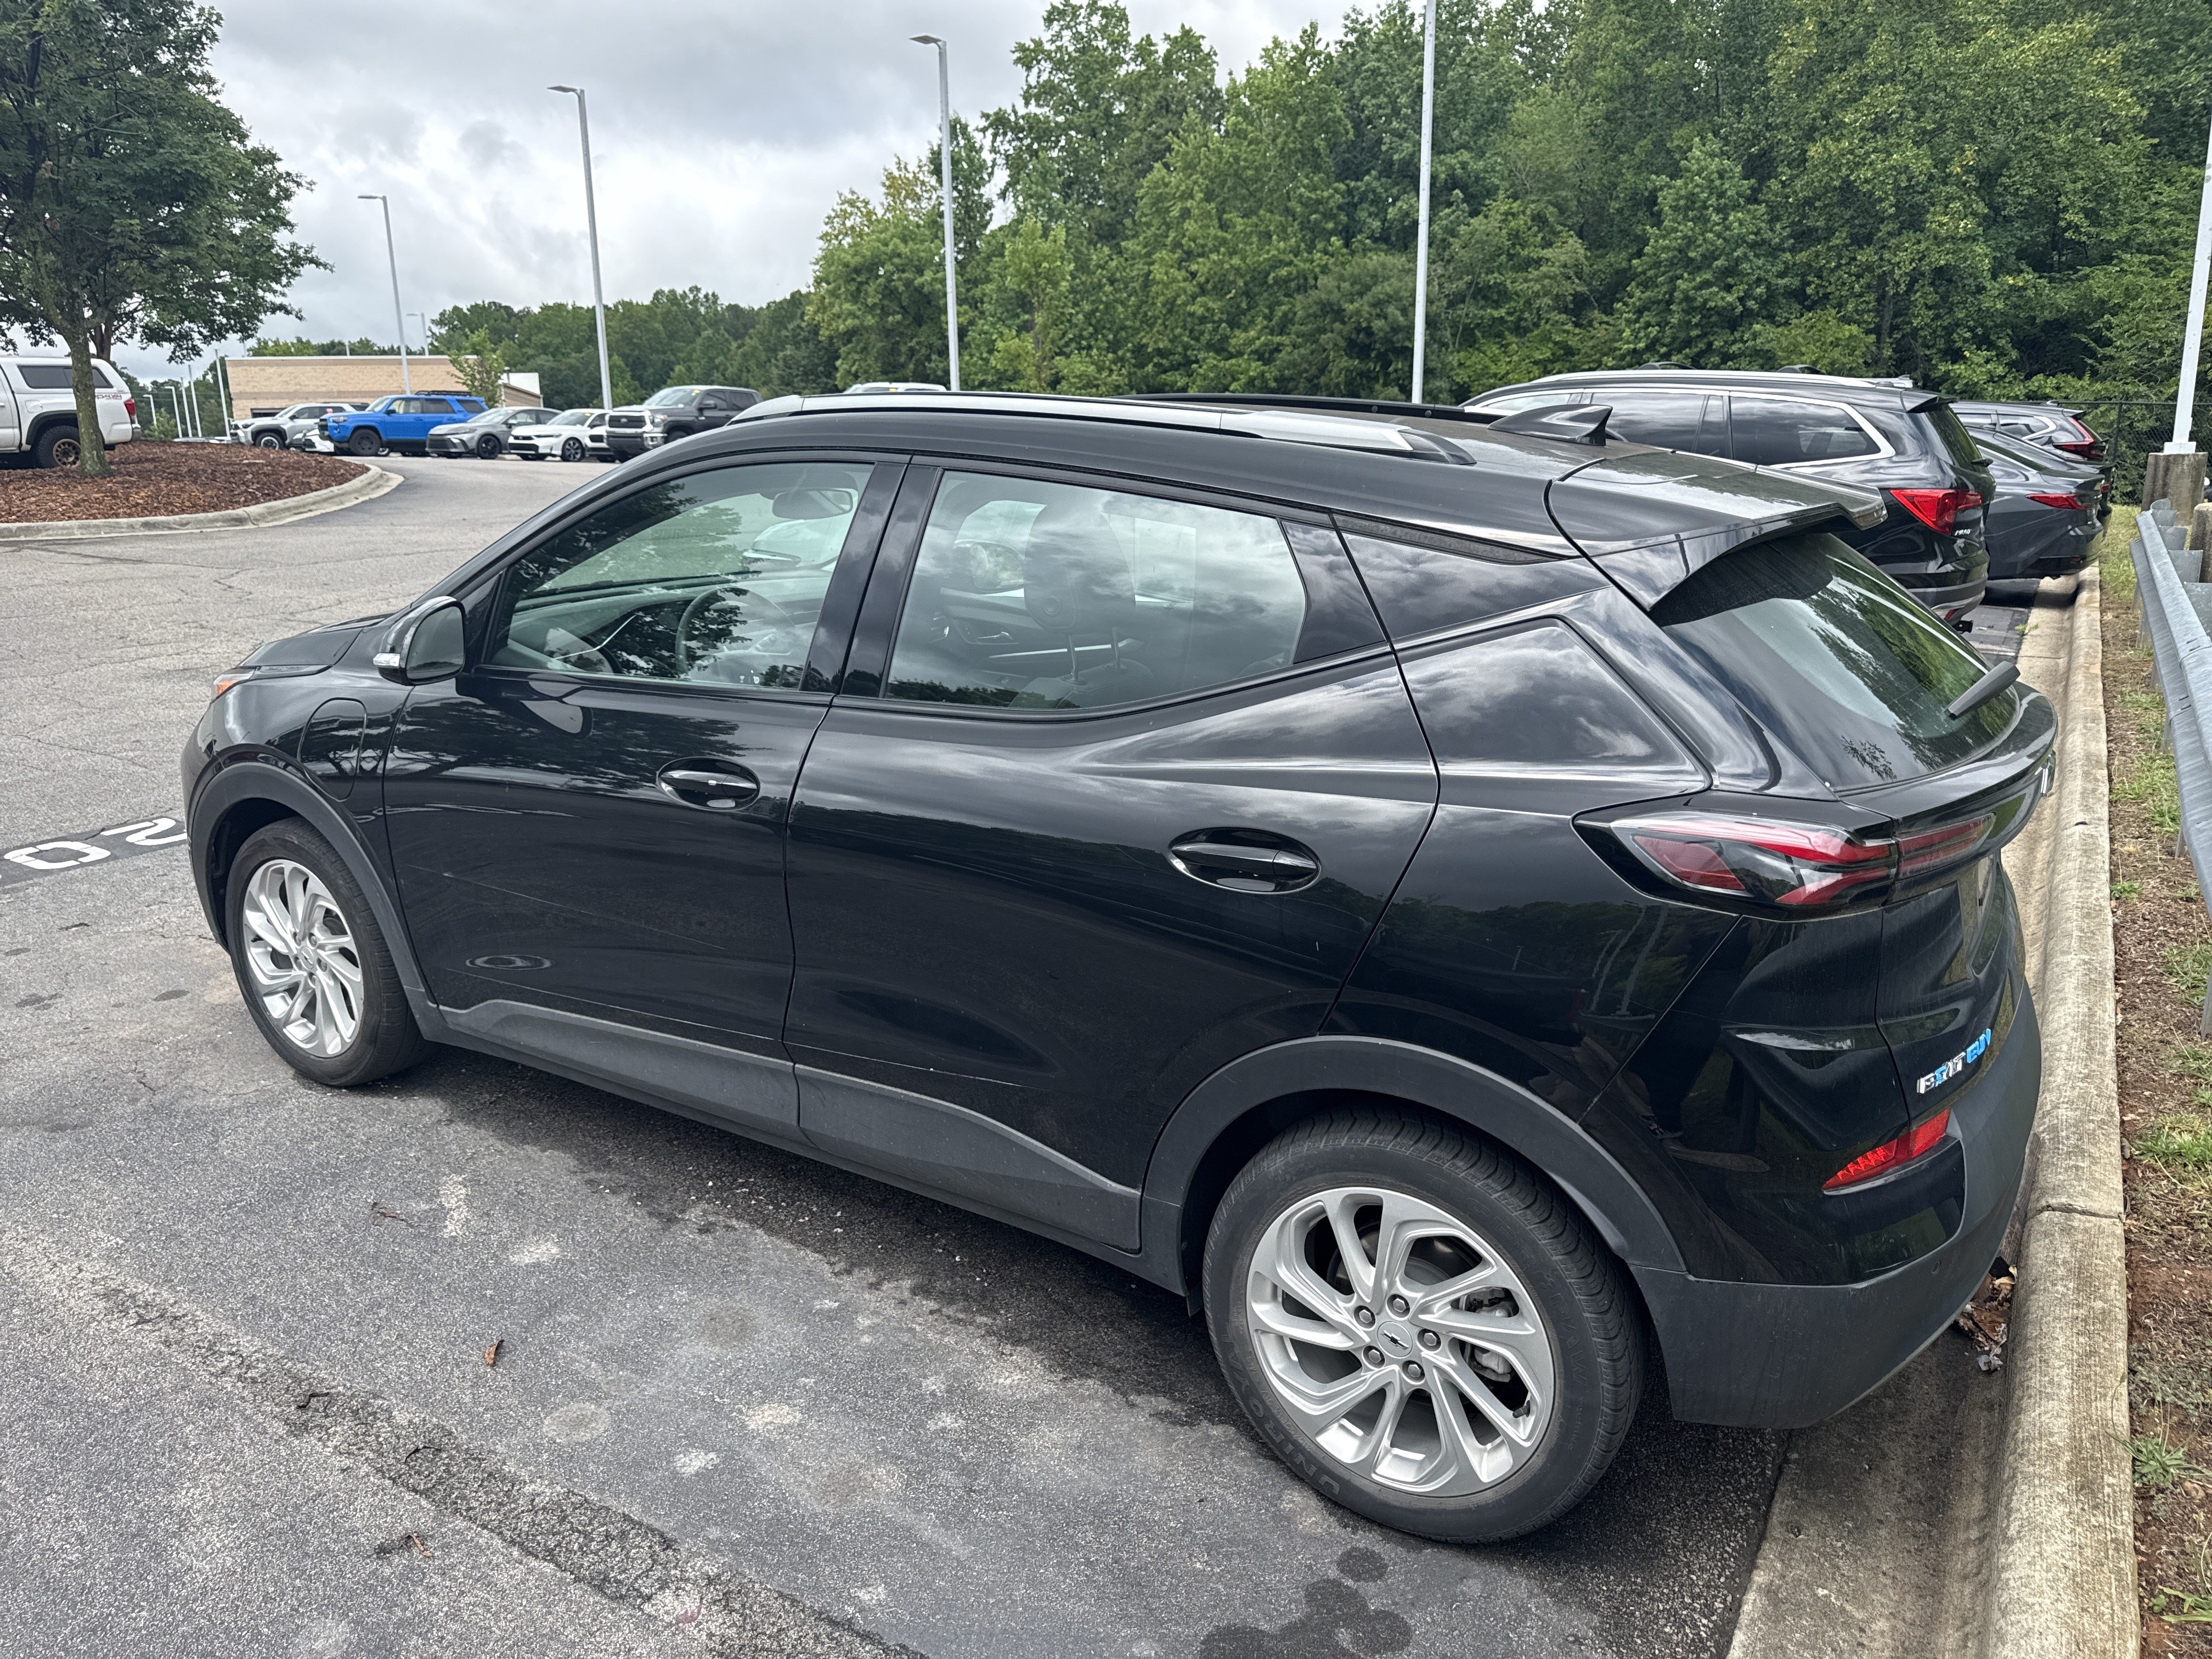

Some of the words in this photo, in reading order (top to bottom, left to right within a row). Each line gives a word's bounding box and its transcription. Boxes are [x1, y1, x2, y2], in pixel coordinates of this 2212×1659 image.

[1966, 1028, 1991, 1063] EUV
[1426, 1175, 1538, 1268] TIGER
[1550, 1291, 1586, 1386] PAW
[1222, 1323, 1340, 1495] UNIROYAL
